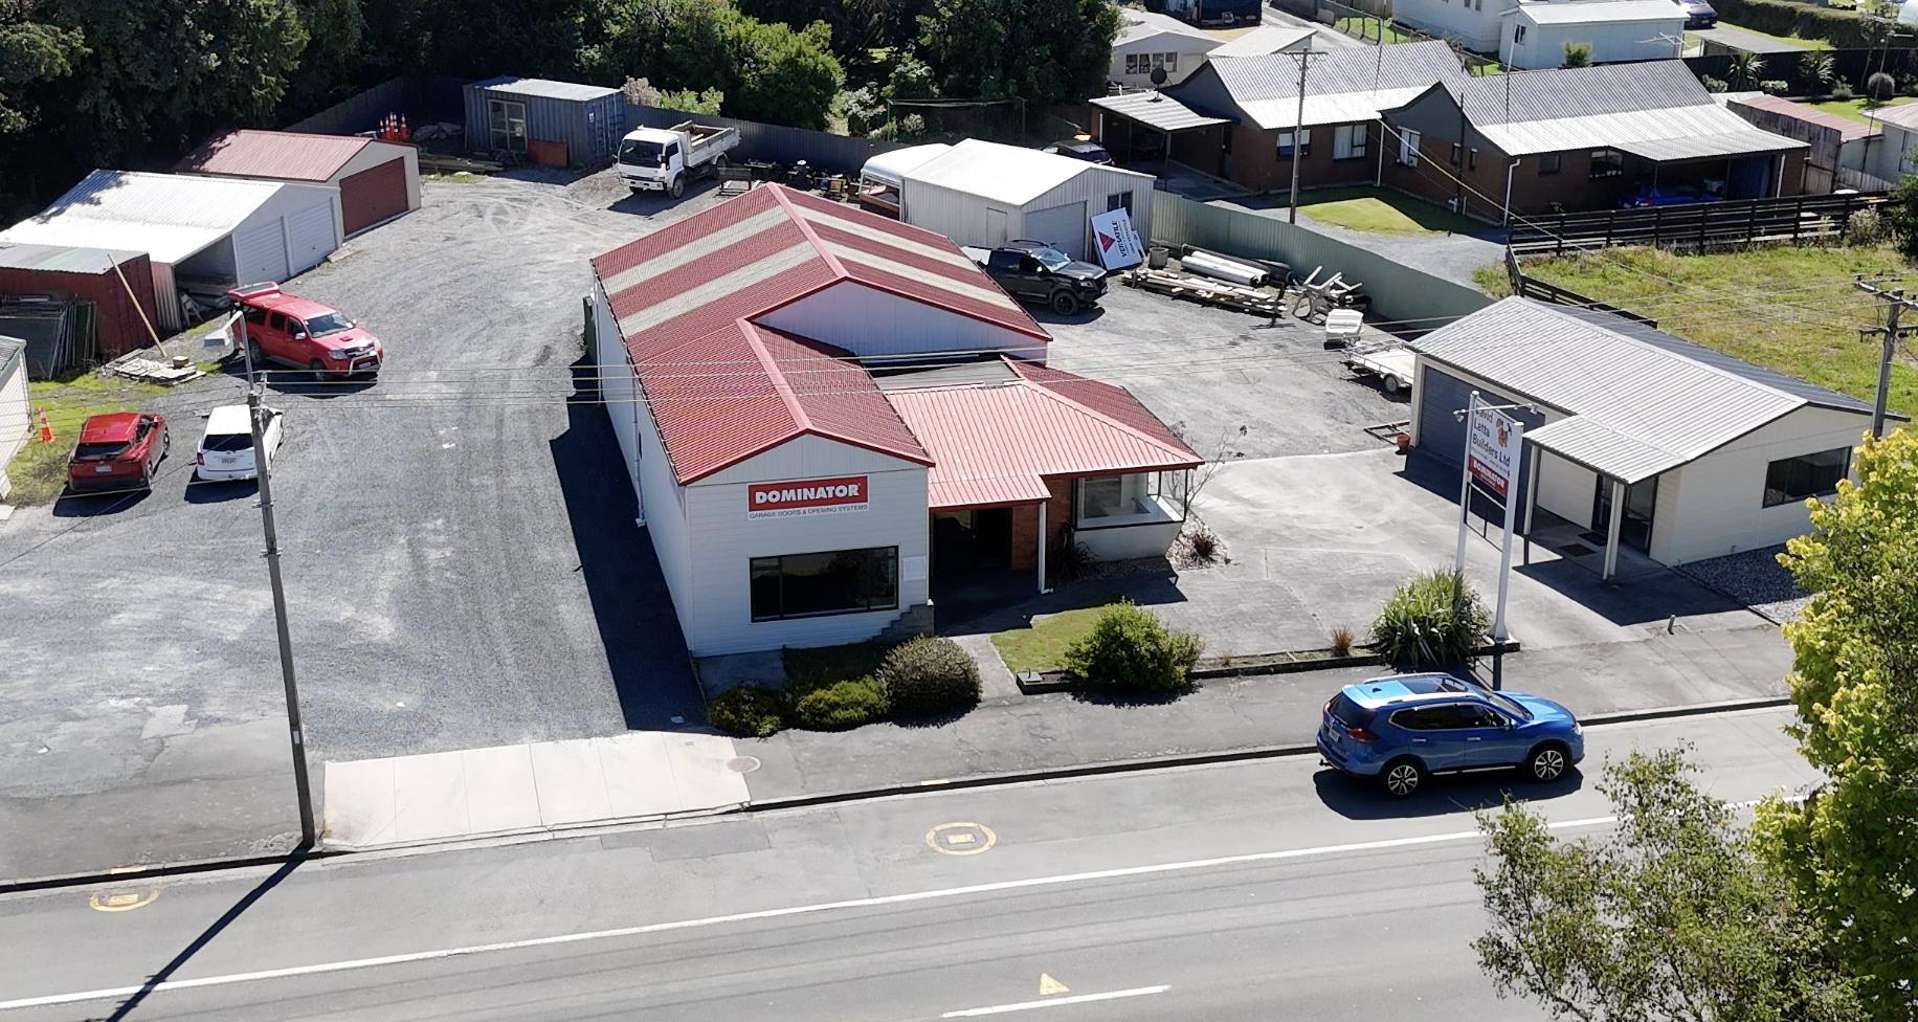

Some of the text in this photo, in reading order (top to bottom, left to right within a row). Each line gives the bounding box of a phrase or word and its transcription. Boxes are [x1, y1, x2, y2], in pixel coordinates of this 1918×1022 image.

[1111, 219, 1127, 258] VERSATILE
[1472, 432, 1498, 460] Builders
[1499, 450, 1511, 468] Ltd
[755, 484, 860, 504] DOMINATOR
[750, 511, 777, 519] GARAGE
[778, 509, 801, 517] DOORS
[808, 506, 837, 514] OPENING
[837, 504, 868, 513] SYSTEMS
